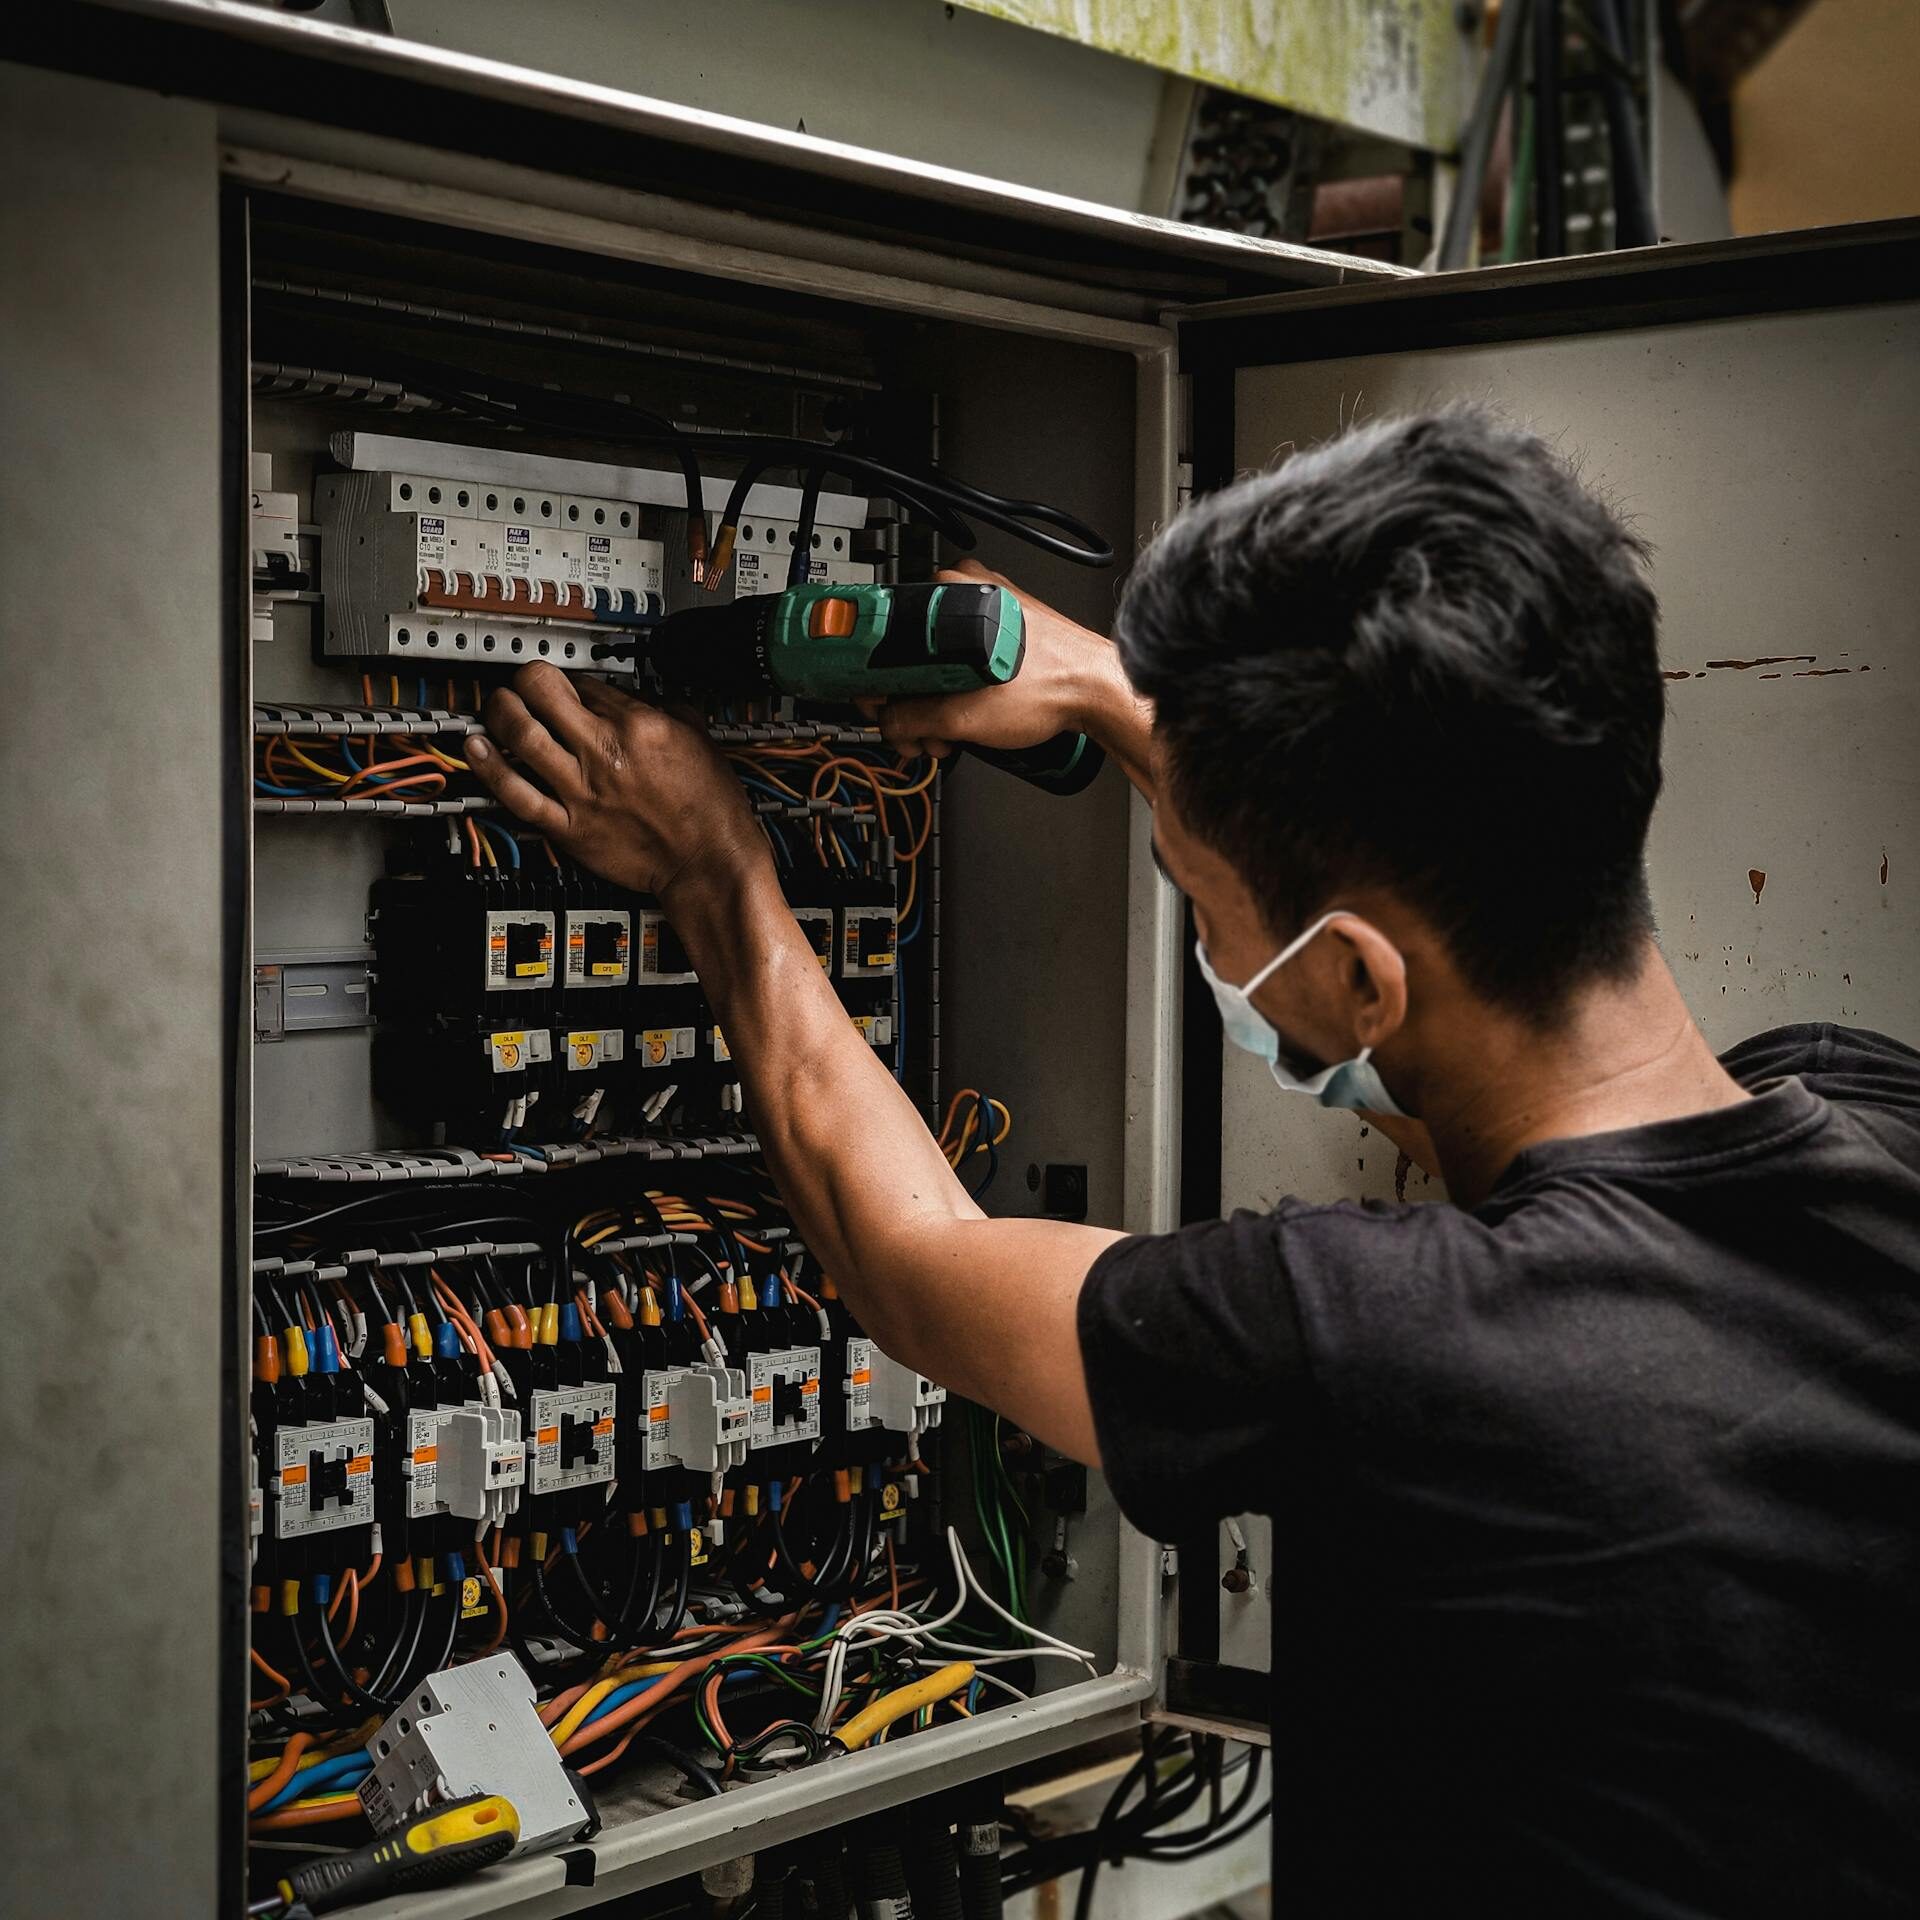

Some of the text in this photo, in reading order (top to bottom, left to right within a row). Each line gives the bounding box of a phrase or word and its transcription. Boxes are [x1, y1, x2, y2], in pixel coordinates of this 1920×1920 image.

[422, 518, 437, 527] MAX
[421, 525, 443, 534] GUARD
[508, 528, 523, 536] MAX
[507, 535, 529, 544] GUARD
[590, 537, 604, 545] MAX
[590, 545, 609, 553] GUARD
[740, 561, 759, 569] GUARD
[809, 568, 827, 576] GUARD
[755, 646, 764, 659] 10
